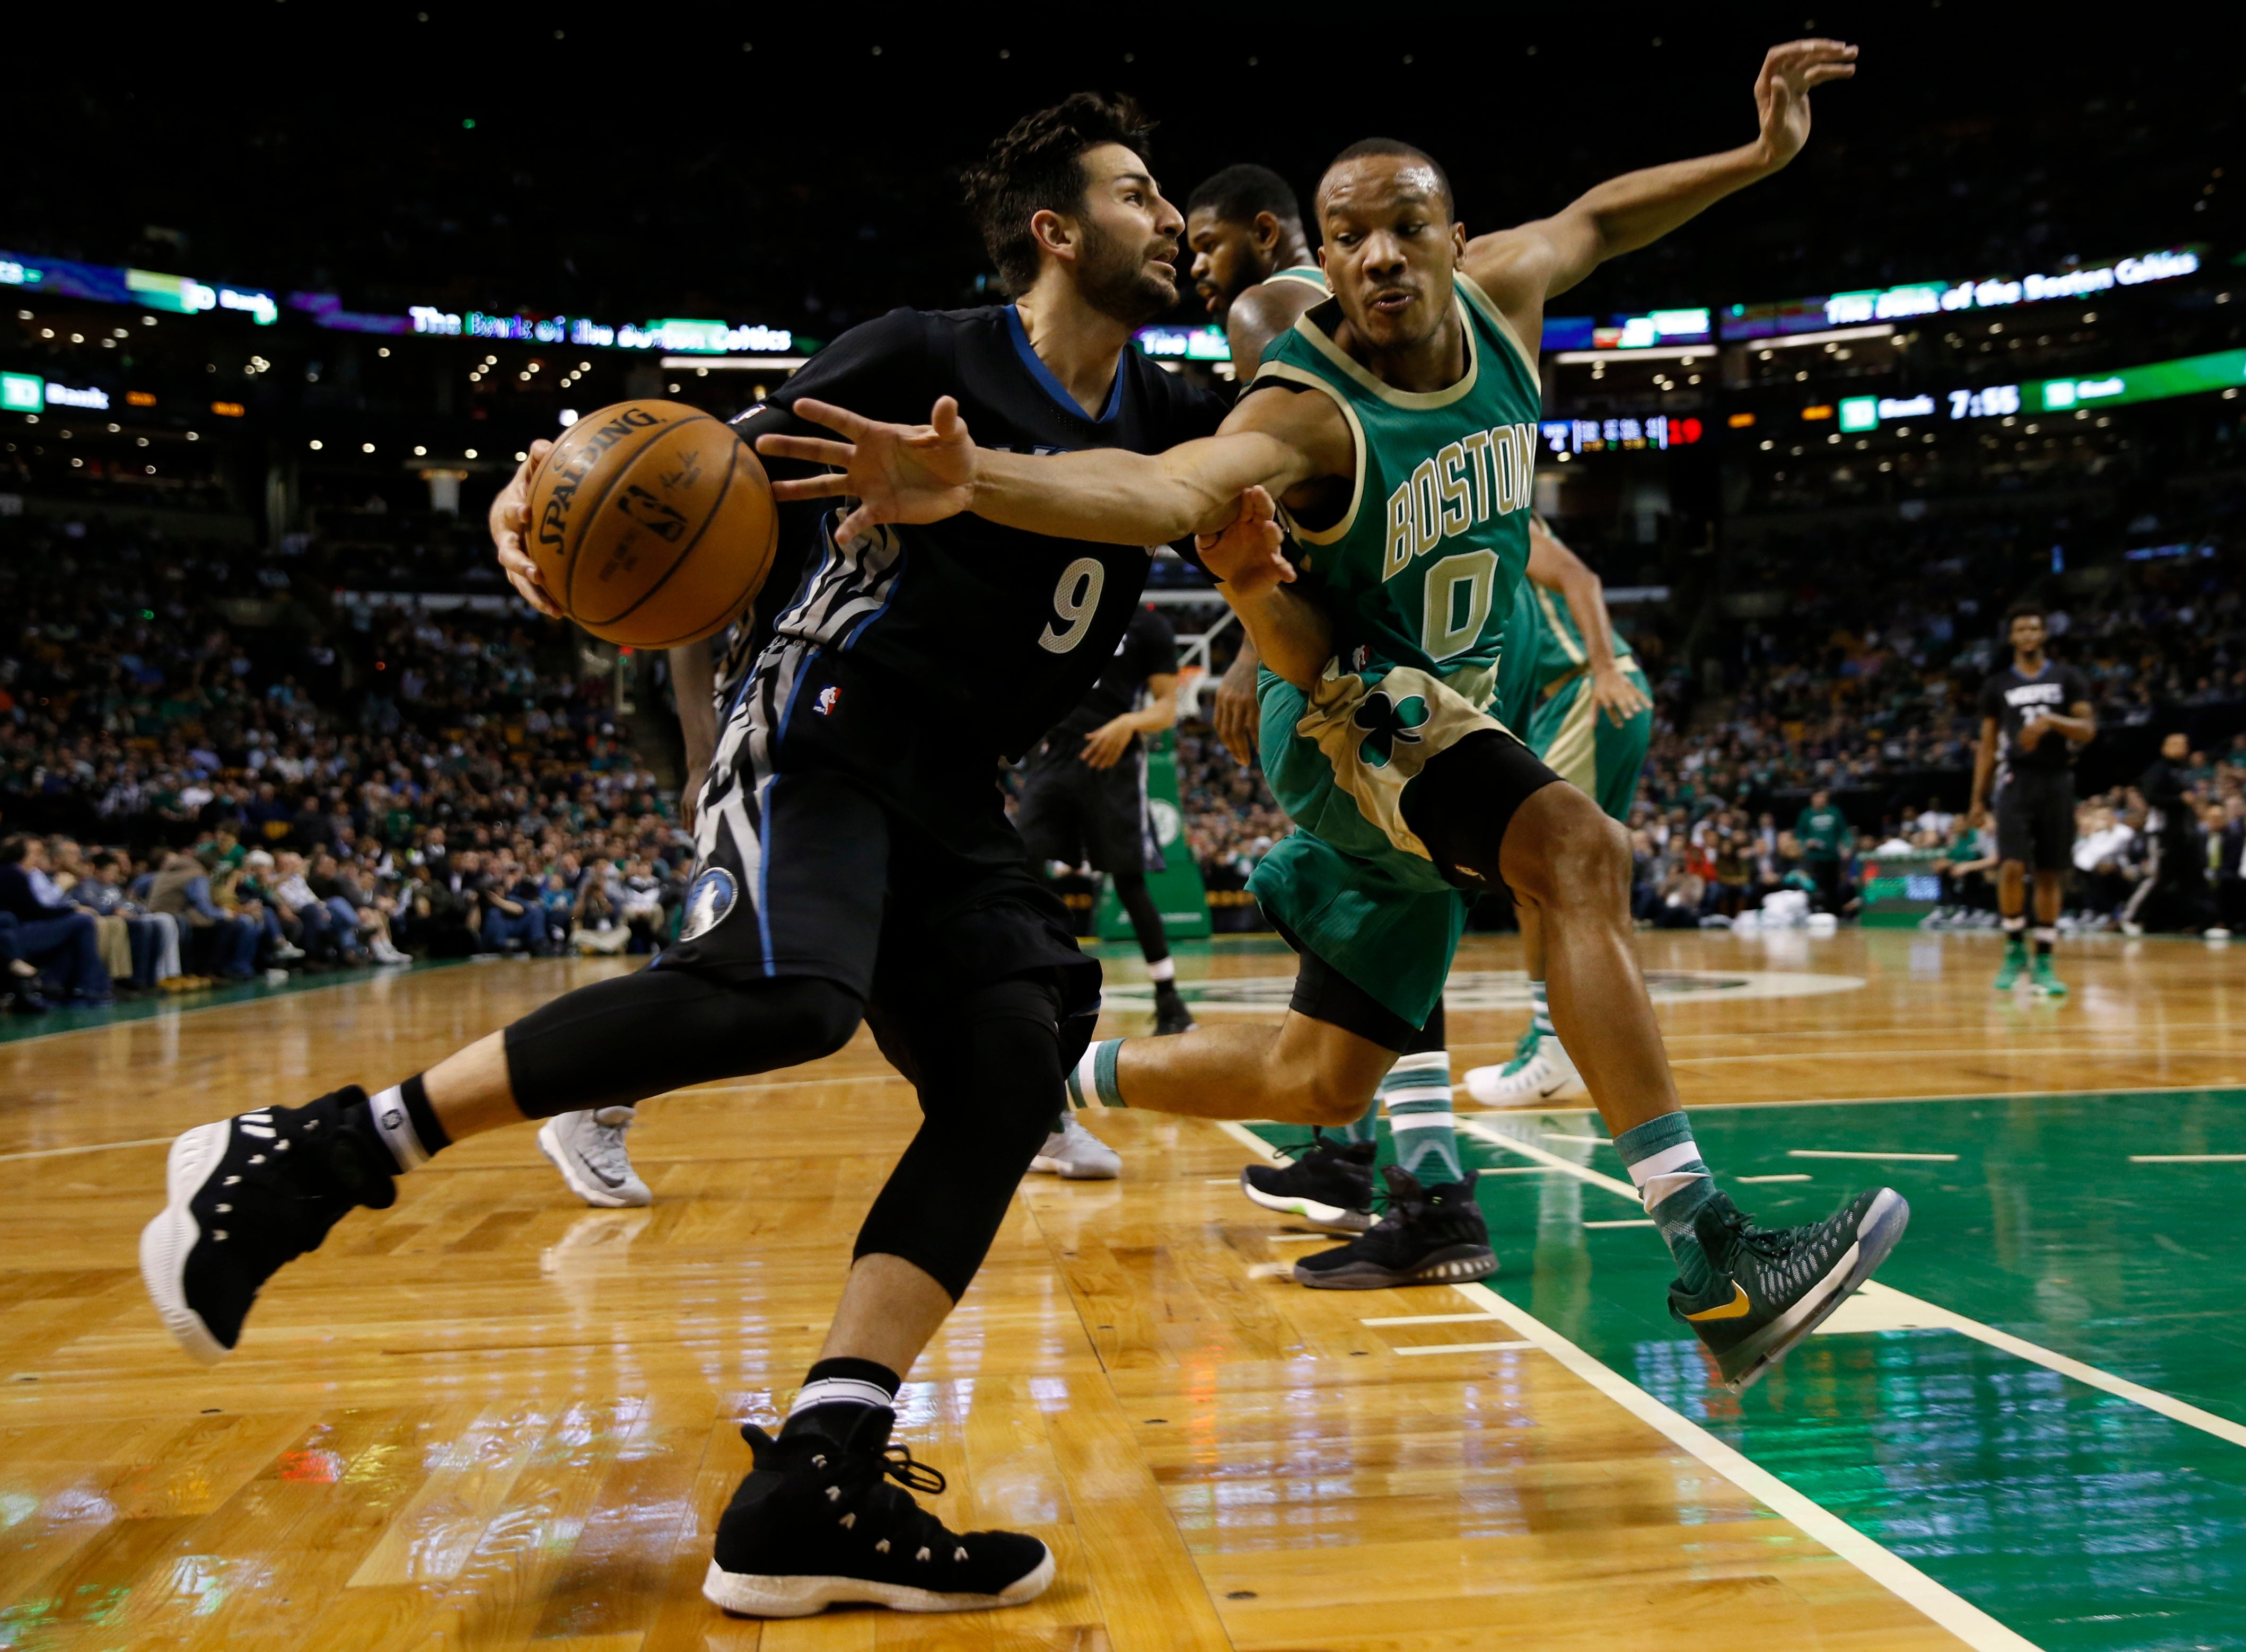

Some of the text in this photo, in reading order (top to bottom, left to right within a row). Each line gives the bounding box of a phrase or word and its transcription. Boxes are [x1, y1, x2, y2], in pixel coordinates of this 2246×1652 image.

[410, 306, 461, 335] The
[1941, 280, 1974, 311] of
[1975, 279, 2022, 307] the
[1948, 384, 2020, 420] 7:55
[539, 408, 659, 555] SPALDING
[1382, 423, 1537, 583] BOSTON
[1038, 557, 1105, 654] 9
[1421, 548, 1499, 663] 0
